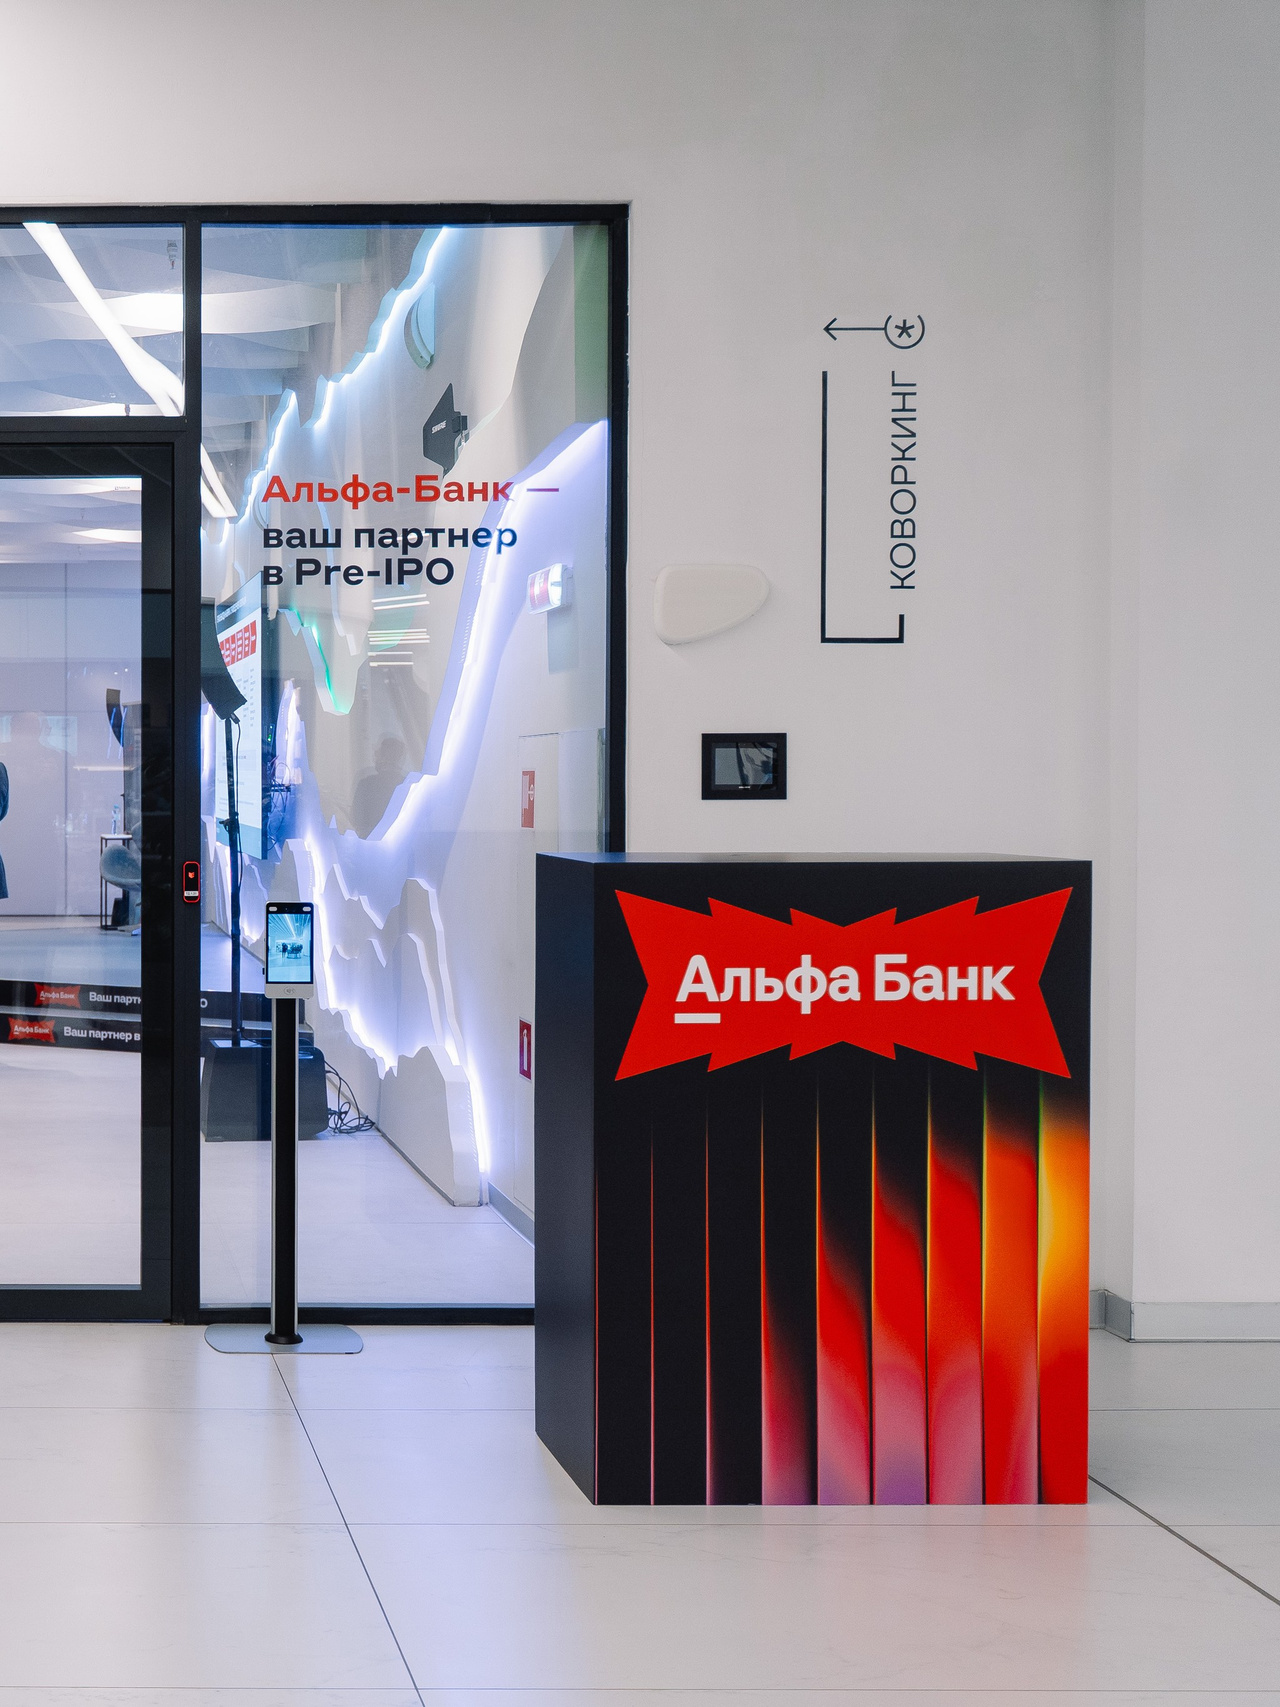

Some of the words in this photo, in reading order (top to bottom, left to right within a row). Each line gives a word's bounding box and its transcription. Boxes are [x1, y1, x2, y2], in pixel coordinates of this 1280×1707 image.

[261, 474, 514, 510] Альфа-Банк
[889, 370, 918, 591] КОВОРКИНГ
[263, 528, 342, 549] ваш
[354, 528, 519, 555] партнер
[263, 566, 285, 586] в
[296, 558, 455, 587] Pre-IPO
[39, 990, 59, 1001] Альфа
[60, 991, 76, 1000] Банк
[88, 991, 112, 1003] Ваш
[674, 954, 861, 1025] Альфа
[874, 953, 1016, 1003] Банк
[13, 1024, 34, 1035] Альфа
[34, 1026, 50, 1035] Банк
[63, 1026, 87, 1038] Ваш
[88, 1029, 132, 1043] партнер
[133, 1032, 141, 1042] в
